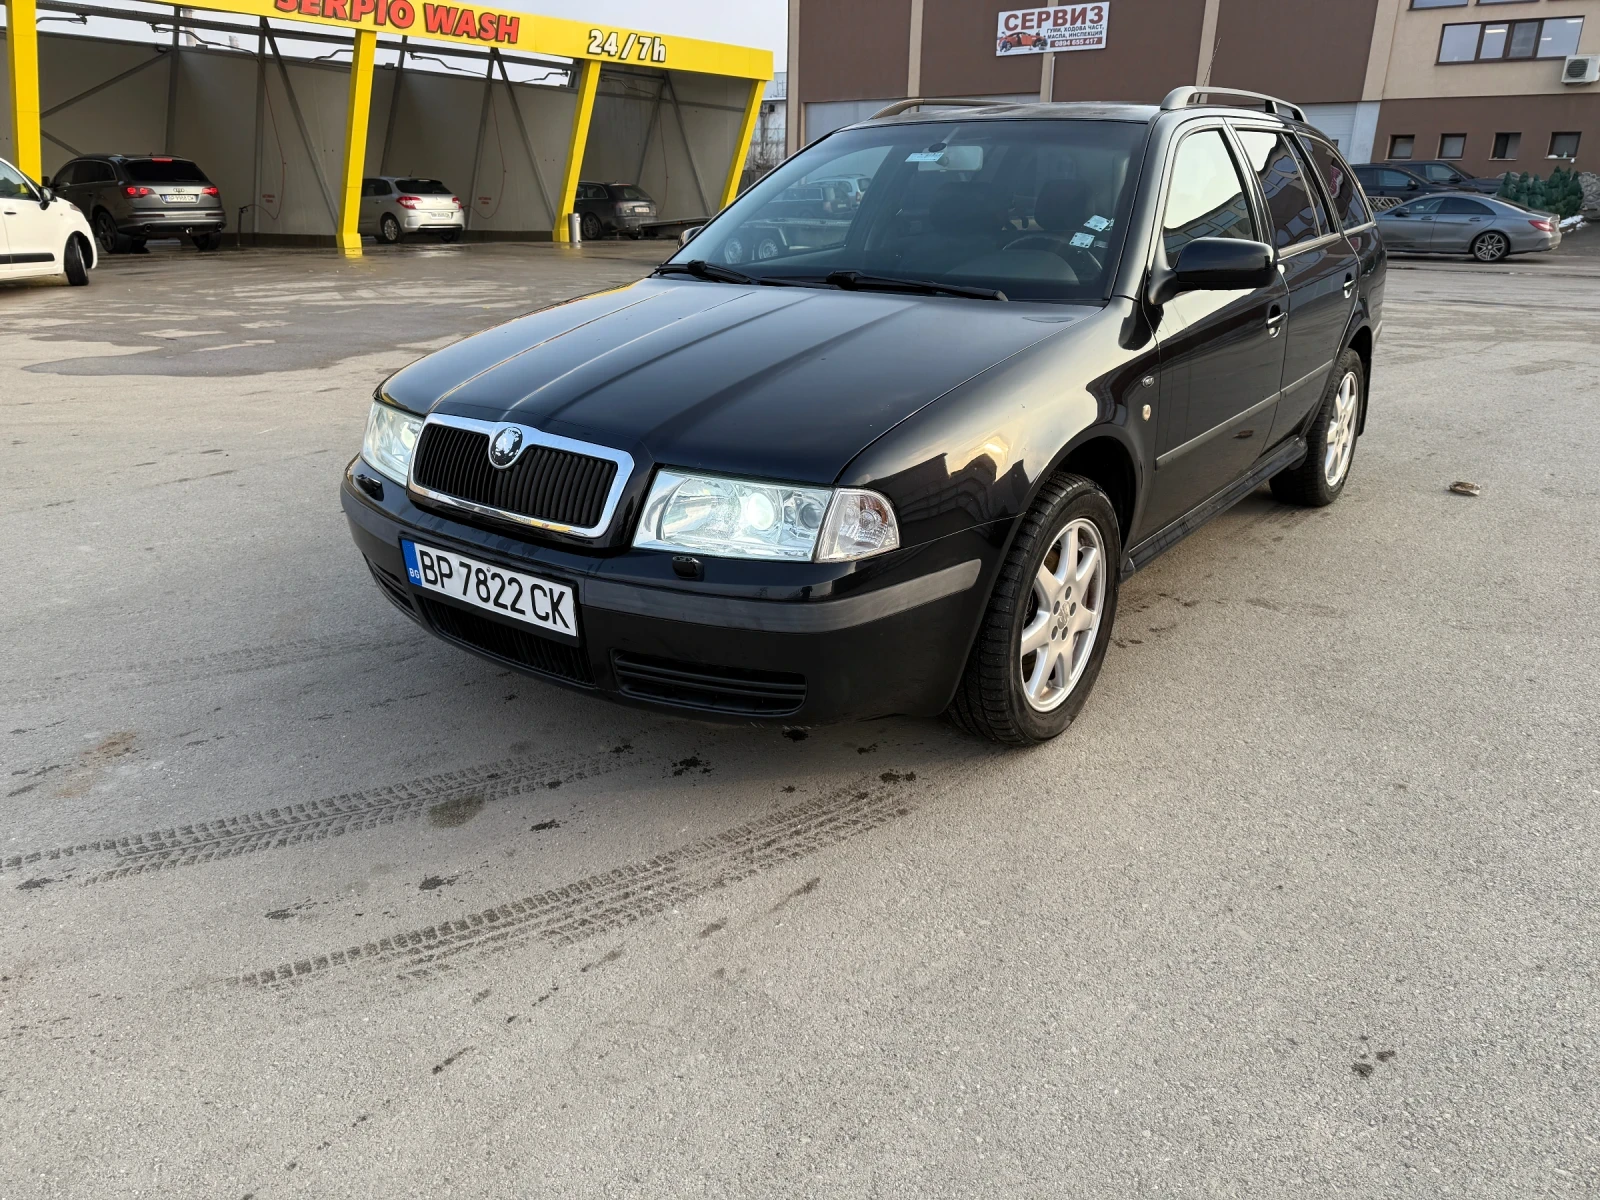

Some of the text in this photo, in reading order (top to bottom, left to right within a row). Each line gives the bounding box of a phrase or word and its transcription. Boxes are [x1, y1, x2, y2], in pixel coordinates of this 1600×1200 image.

[424, 3, 520, 44] WASH
[1004, 6, 1104, 32] СЕРВИЗ
[1063, 25, 1087, 33] ХОДОВА
[587, 28, 667, 63] 24/7h
[409, 567, 420, 579] BG
[419, 549, 570, 629] BP 7822 CK
